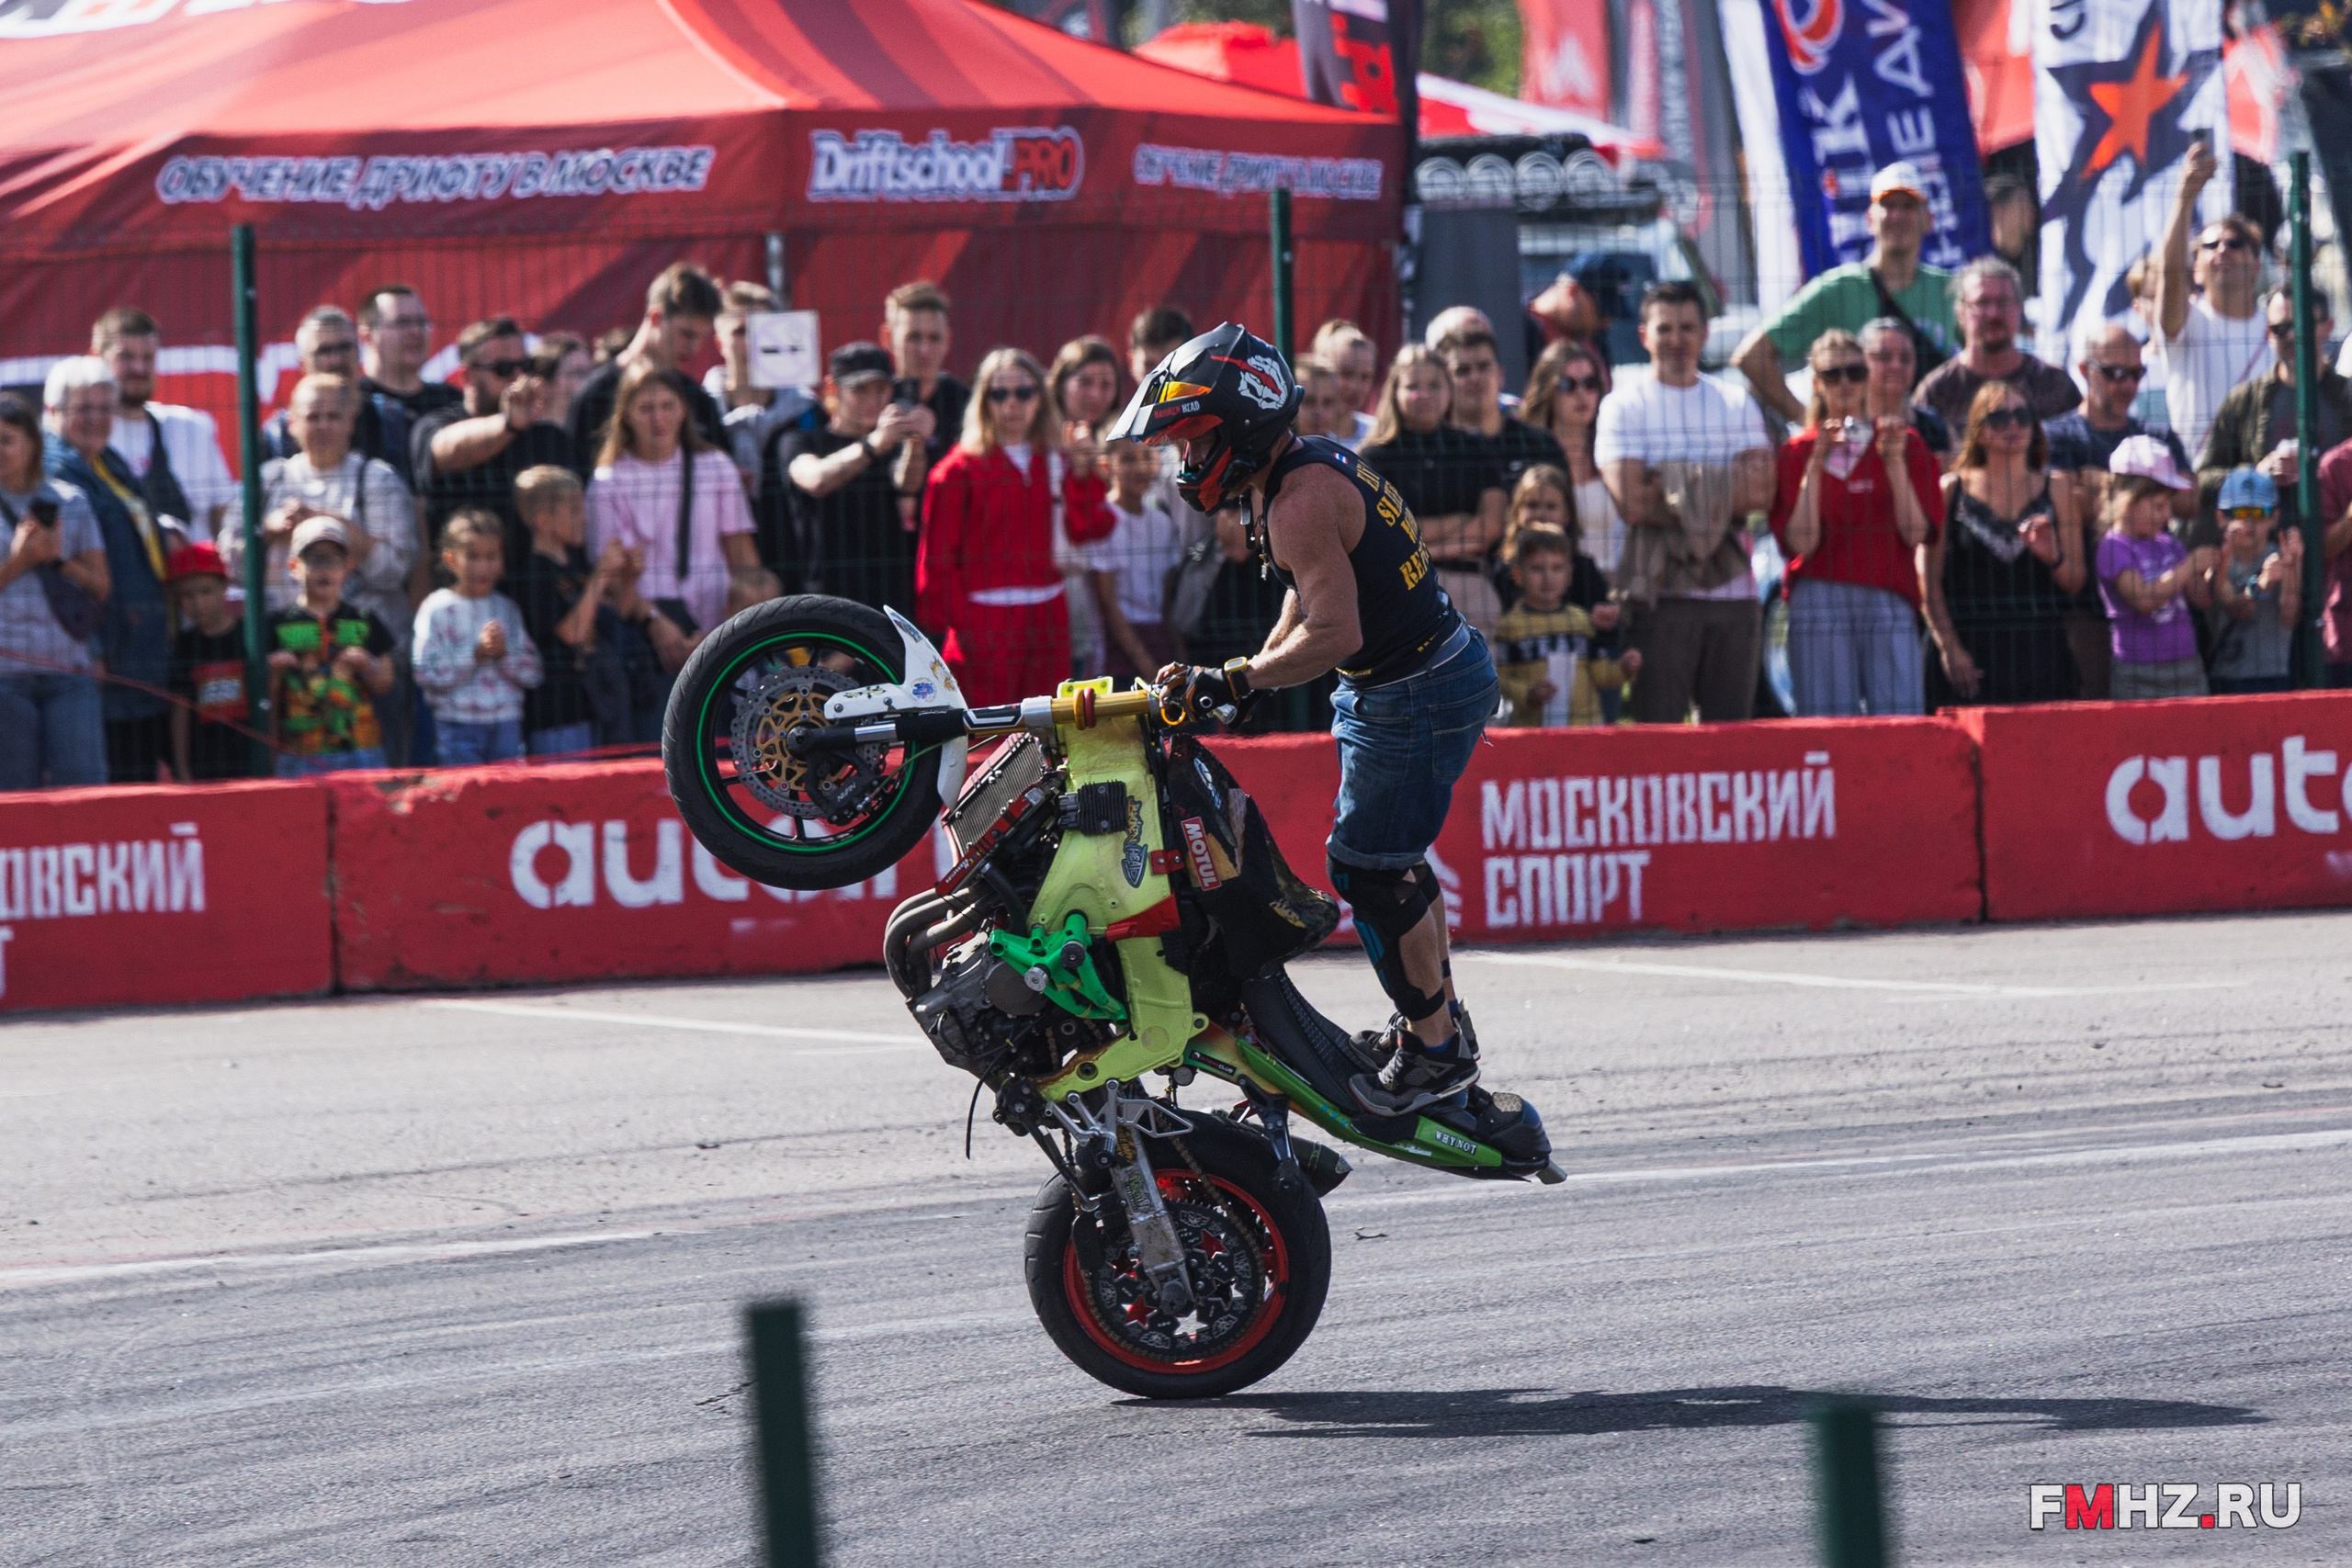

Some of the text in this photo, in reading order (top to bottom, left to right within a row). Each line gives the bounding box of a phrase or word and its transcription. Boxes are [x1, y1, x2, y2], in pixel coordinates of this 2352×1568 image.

[156, 144, 717, 210] ОБУЧЕНИЕ ДРИФТУ В МОСКВЕ
[1182, 400, 1201, 412] HEAD
[1480, 750, 1836, 850] МОСКОВСКИЙ
[1184, 822, 1217, 887] MOTUL
[1484, 849, 1651, 928] СПОРТ
